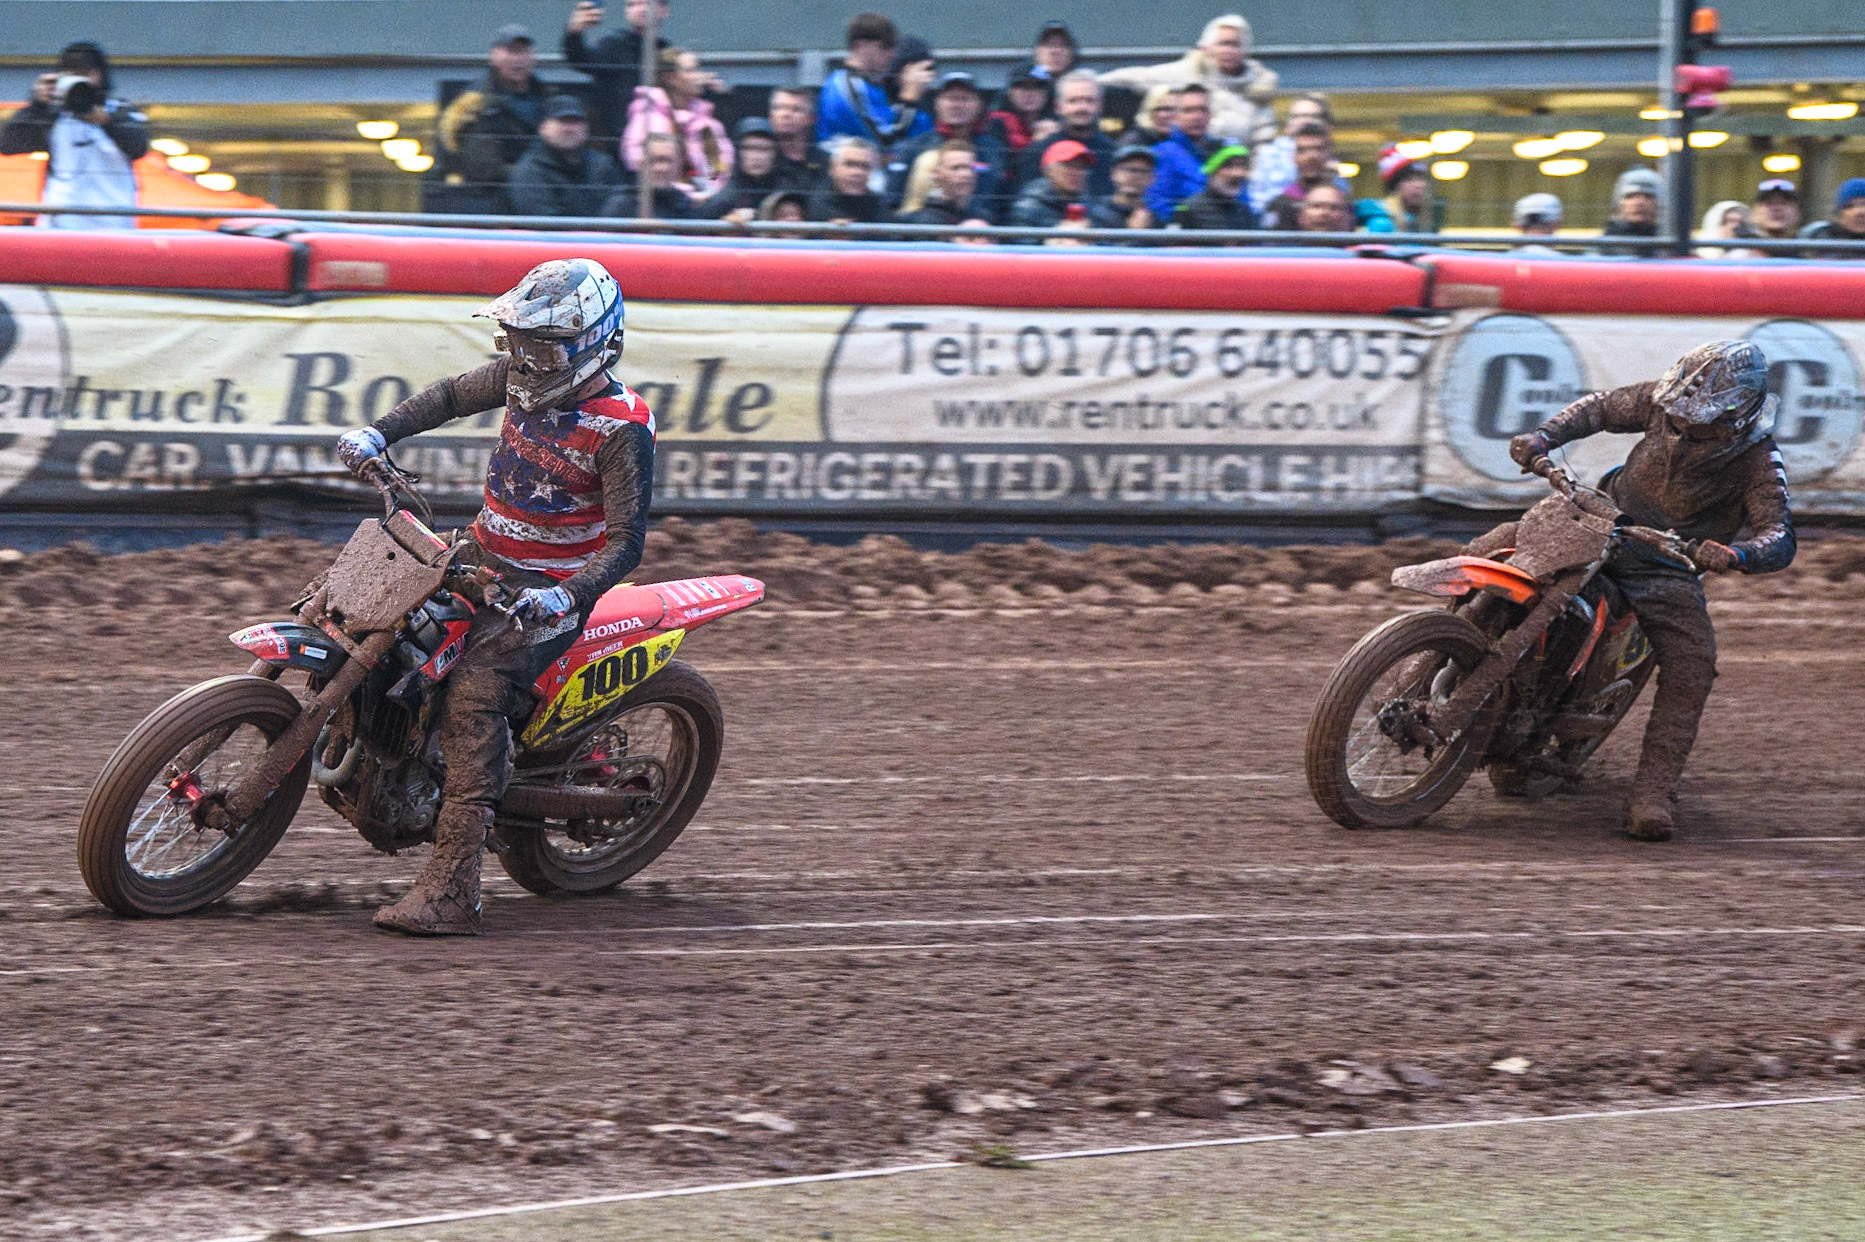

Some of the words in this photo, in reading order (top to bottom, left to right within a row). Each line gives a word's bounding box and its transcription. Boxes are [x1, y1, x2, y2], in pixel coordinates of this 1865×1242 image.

[886, 322, 999, 377] Tel:
[1017, 325, 1197, 378] 01706
[1216, 327, 1422, 380] 640055
[933, 392, 1379, 430] www.rentruck.co.uk
[664, 451, 1073, 500] REFRIGERATED
[1081, 453, 1312, 501] VEHICLE
[583, 616, 644, 642] HONDA
[577, 645, 649, 703] 100
